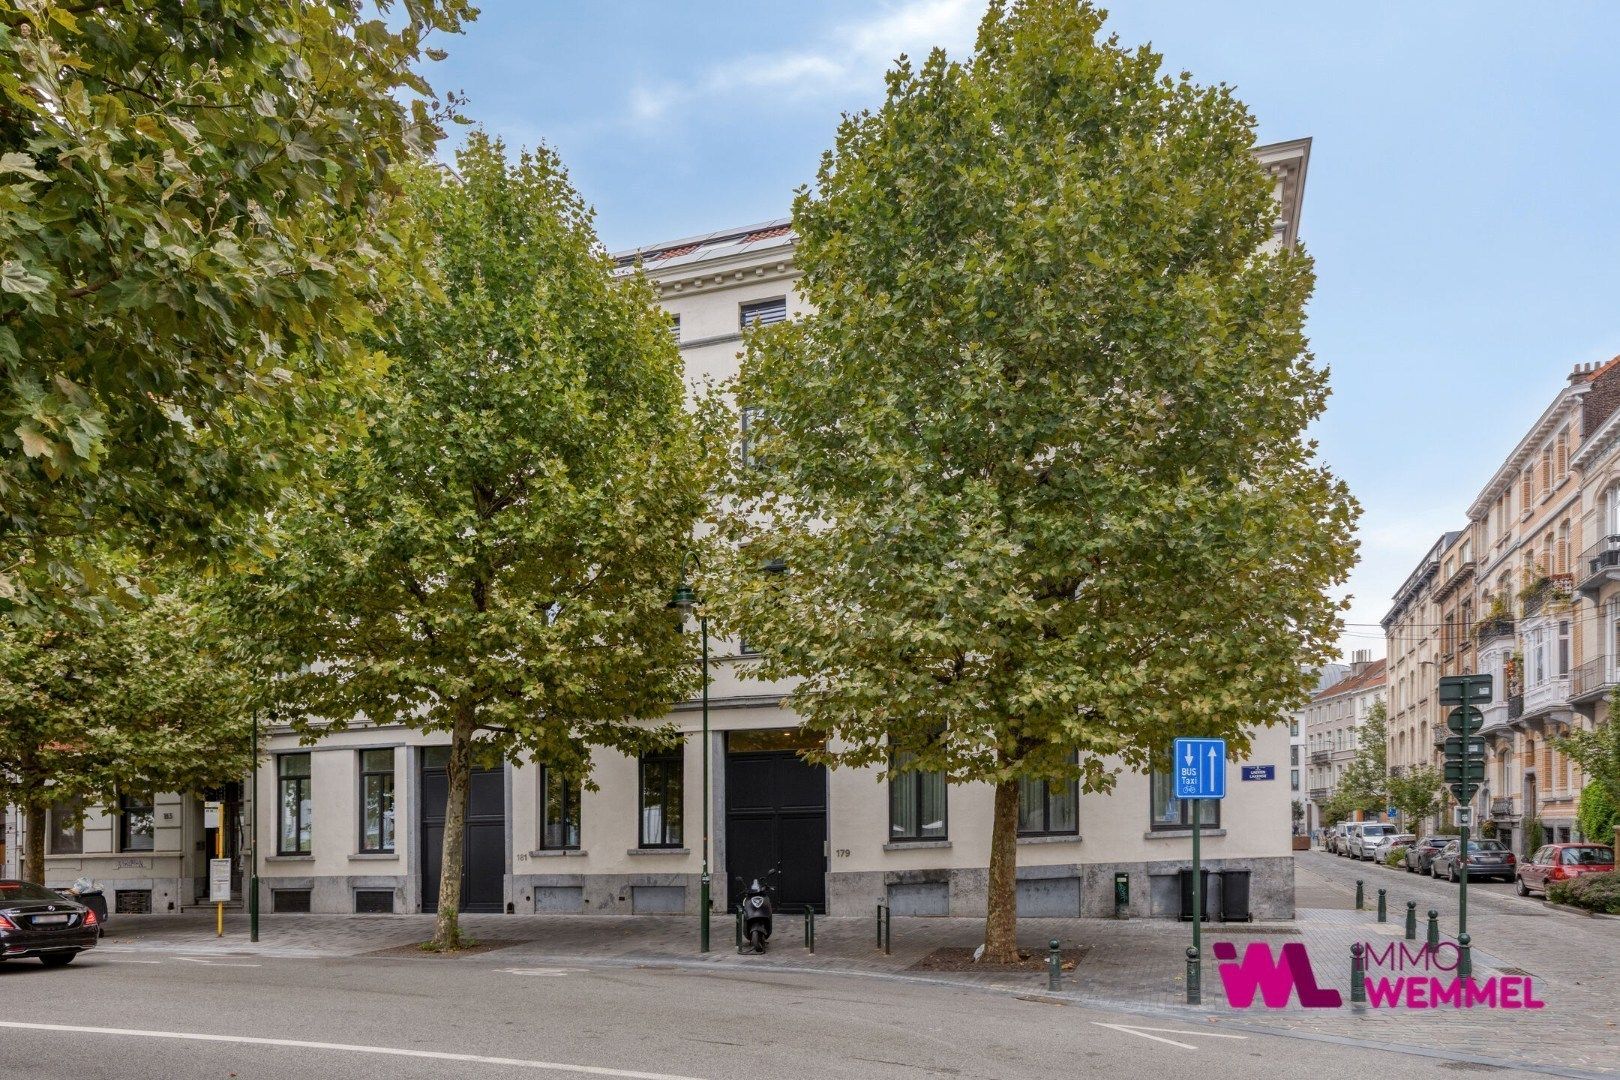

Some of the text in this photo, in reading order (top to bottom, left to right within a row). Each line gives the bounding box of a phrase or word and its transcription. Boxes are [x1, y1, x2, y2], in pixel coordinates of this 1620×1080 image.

[1181, 767, 1197, 776] BUS
[1181, 776, 1198, 785] Taxi
[835, 849, 851, 858] 179
